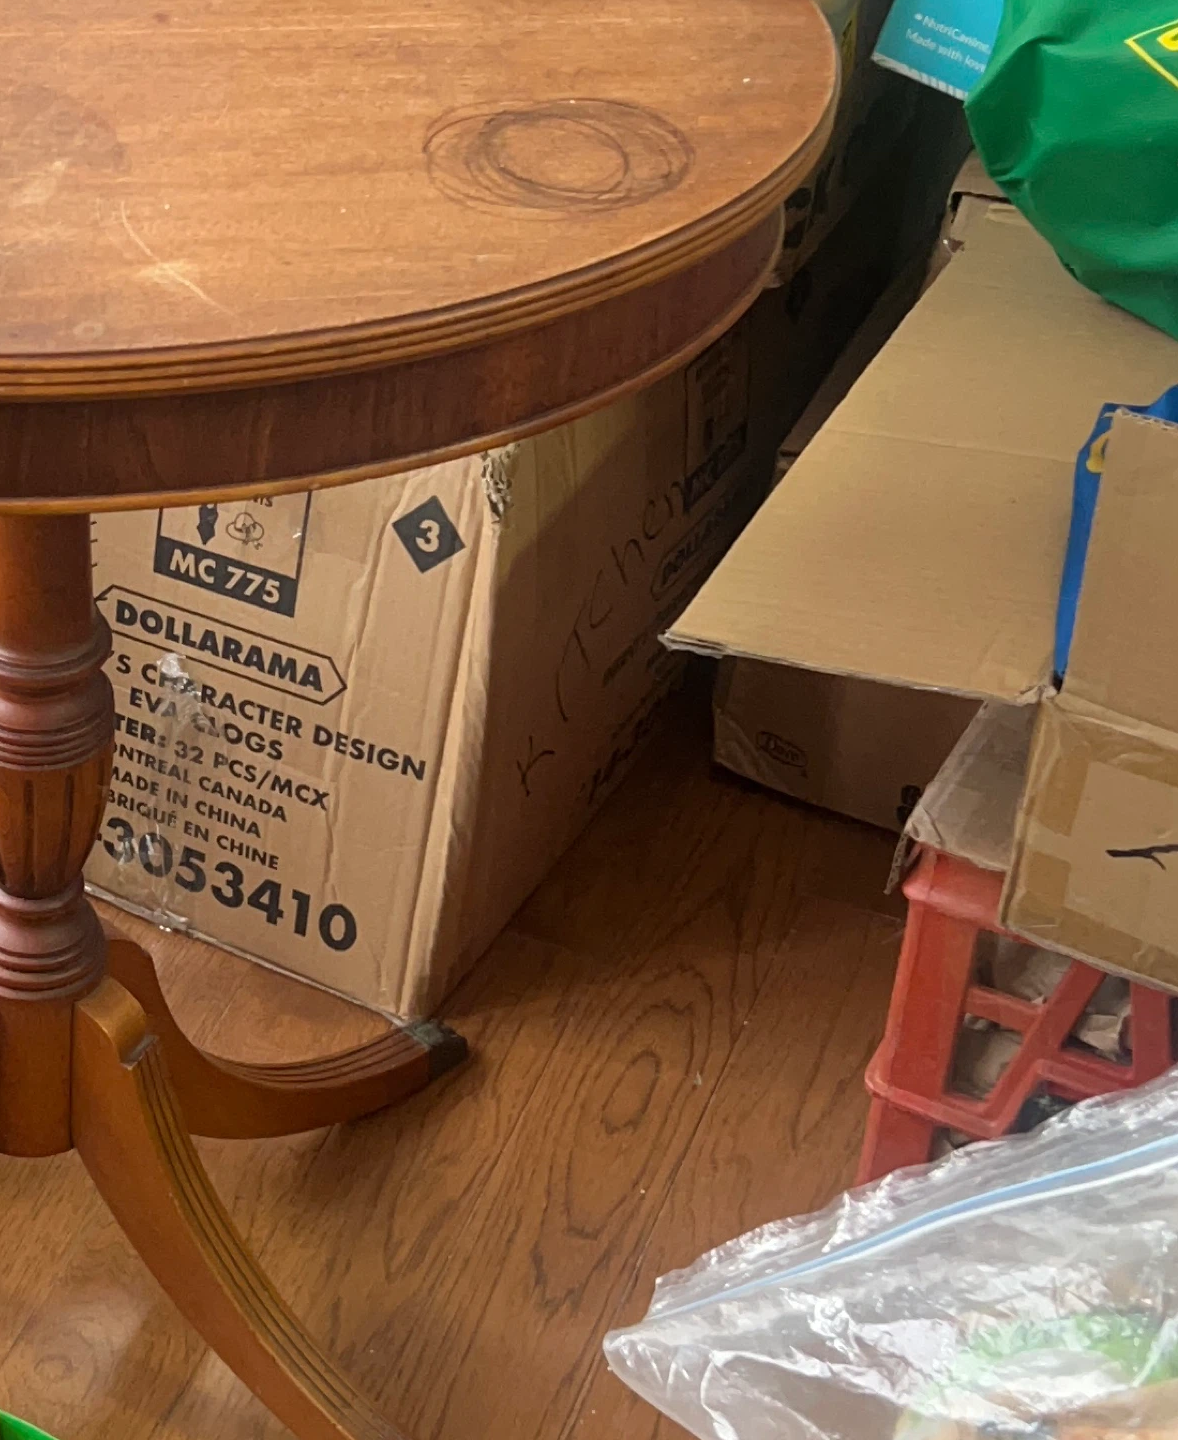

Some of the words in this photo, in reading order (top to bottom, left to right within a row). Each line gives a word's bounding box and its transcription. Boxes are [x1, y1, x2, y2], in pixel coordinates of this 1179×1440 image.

[415, 519, 441, 553] 3
[170, 548, 217, 585] MC
[226, 566, 281, 605] 775
[115, 598, 323, 693] DOLLARAMA
[130, 686, 177, 717] EVA
[191, 712, 283, 760] CLOGS
[174, 740, 204, 765] 32
[213, 752, 330, 811] PCS/MCX
[312, 725, 426, 781] DESIGN
[166, 788, 189, 808] IN
[195, 800, 262, 839] CHINA
[199, 775, 287, 823] CANADA
[184, 820, 210, 842] EN
[216, 834, 280, 871] CHINE
